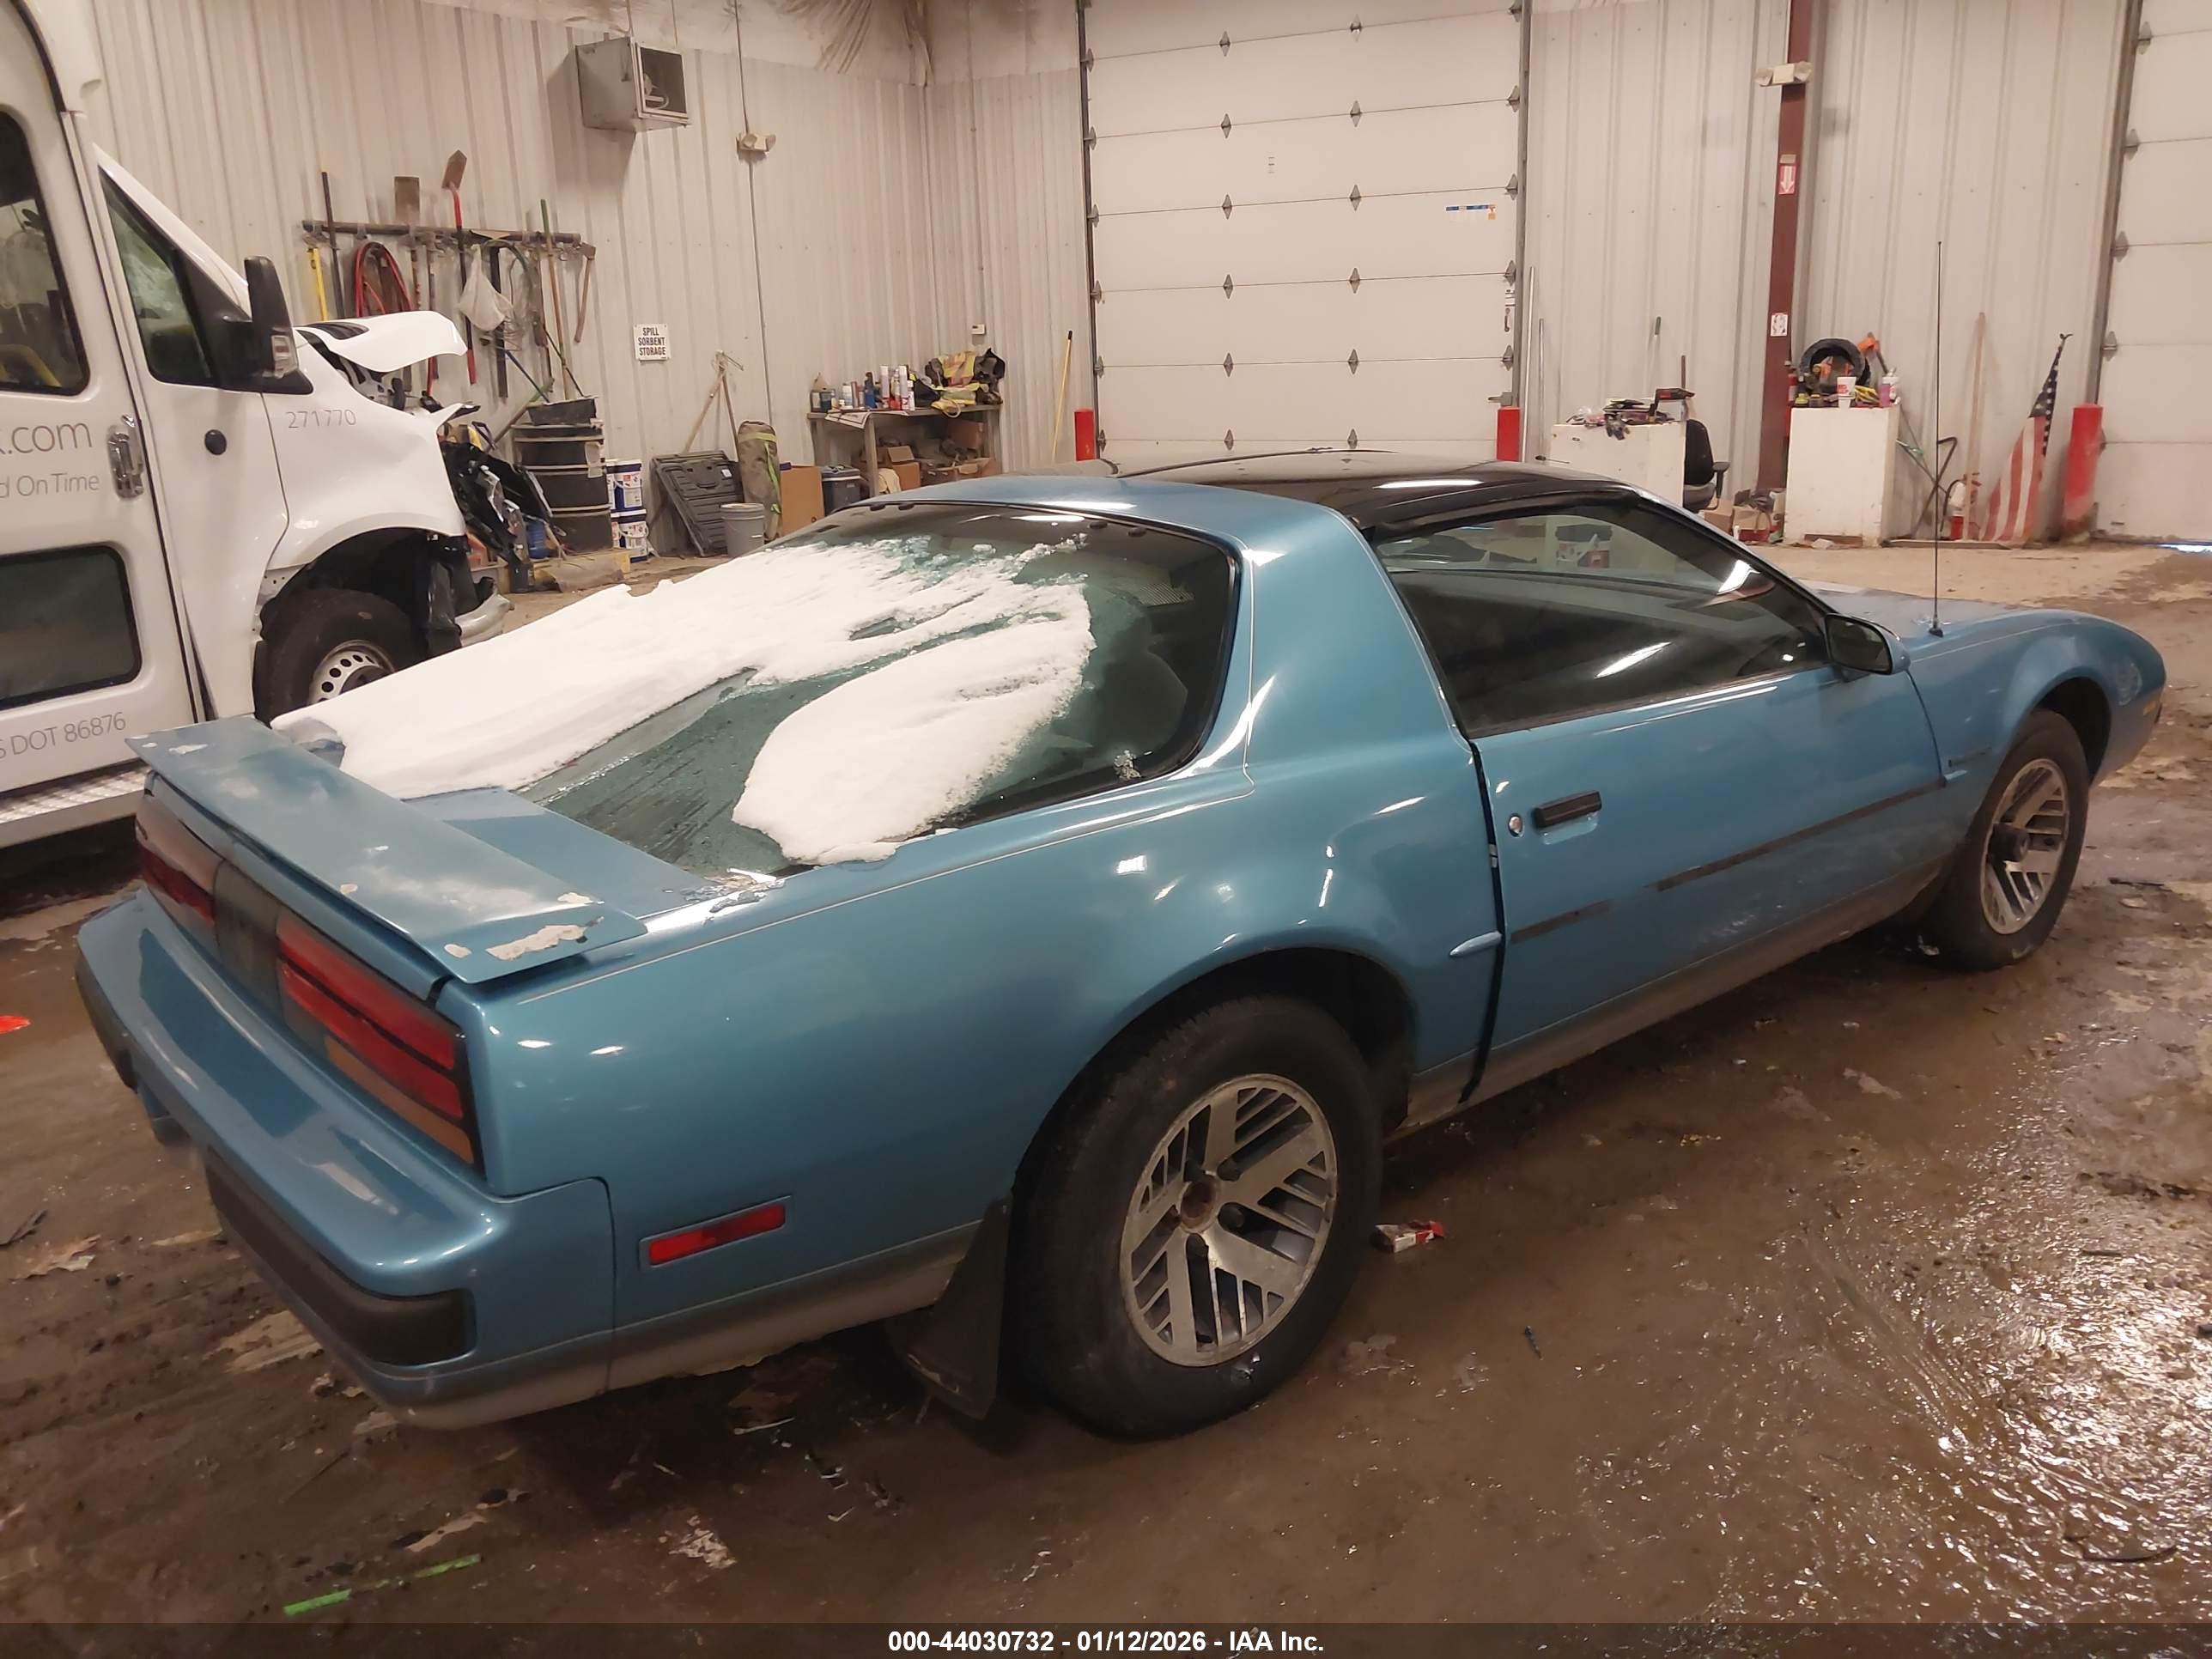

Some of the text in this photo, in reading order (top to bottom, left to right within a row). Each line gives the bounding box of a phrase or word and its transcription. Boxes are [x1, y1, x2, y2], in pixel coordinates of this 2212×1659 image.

[641, 327, 659, 336] SPILL
[638, 337, 665, 346] SORBENT
[639, 347, 666, 356] STORAGE
[286, 409, 357, 428] 271770
[16, 475, 48, 496] On
[50, 472, 100, 494] Time
[10, 726, 58, 755] DOT
[64, 712, 126, 743] 86876
